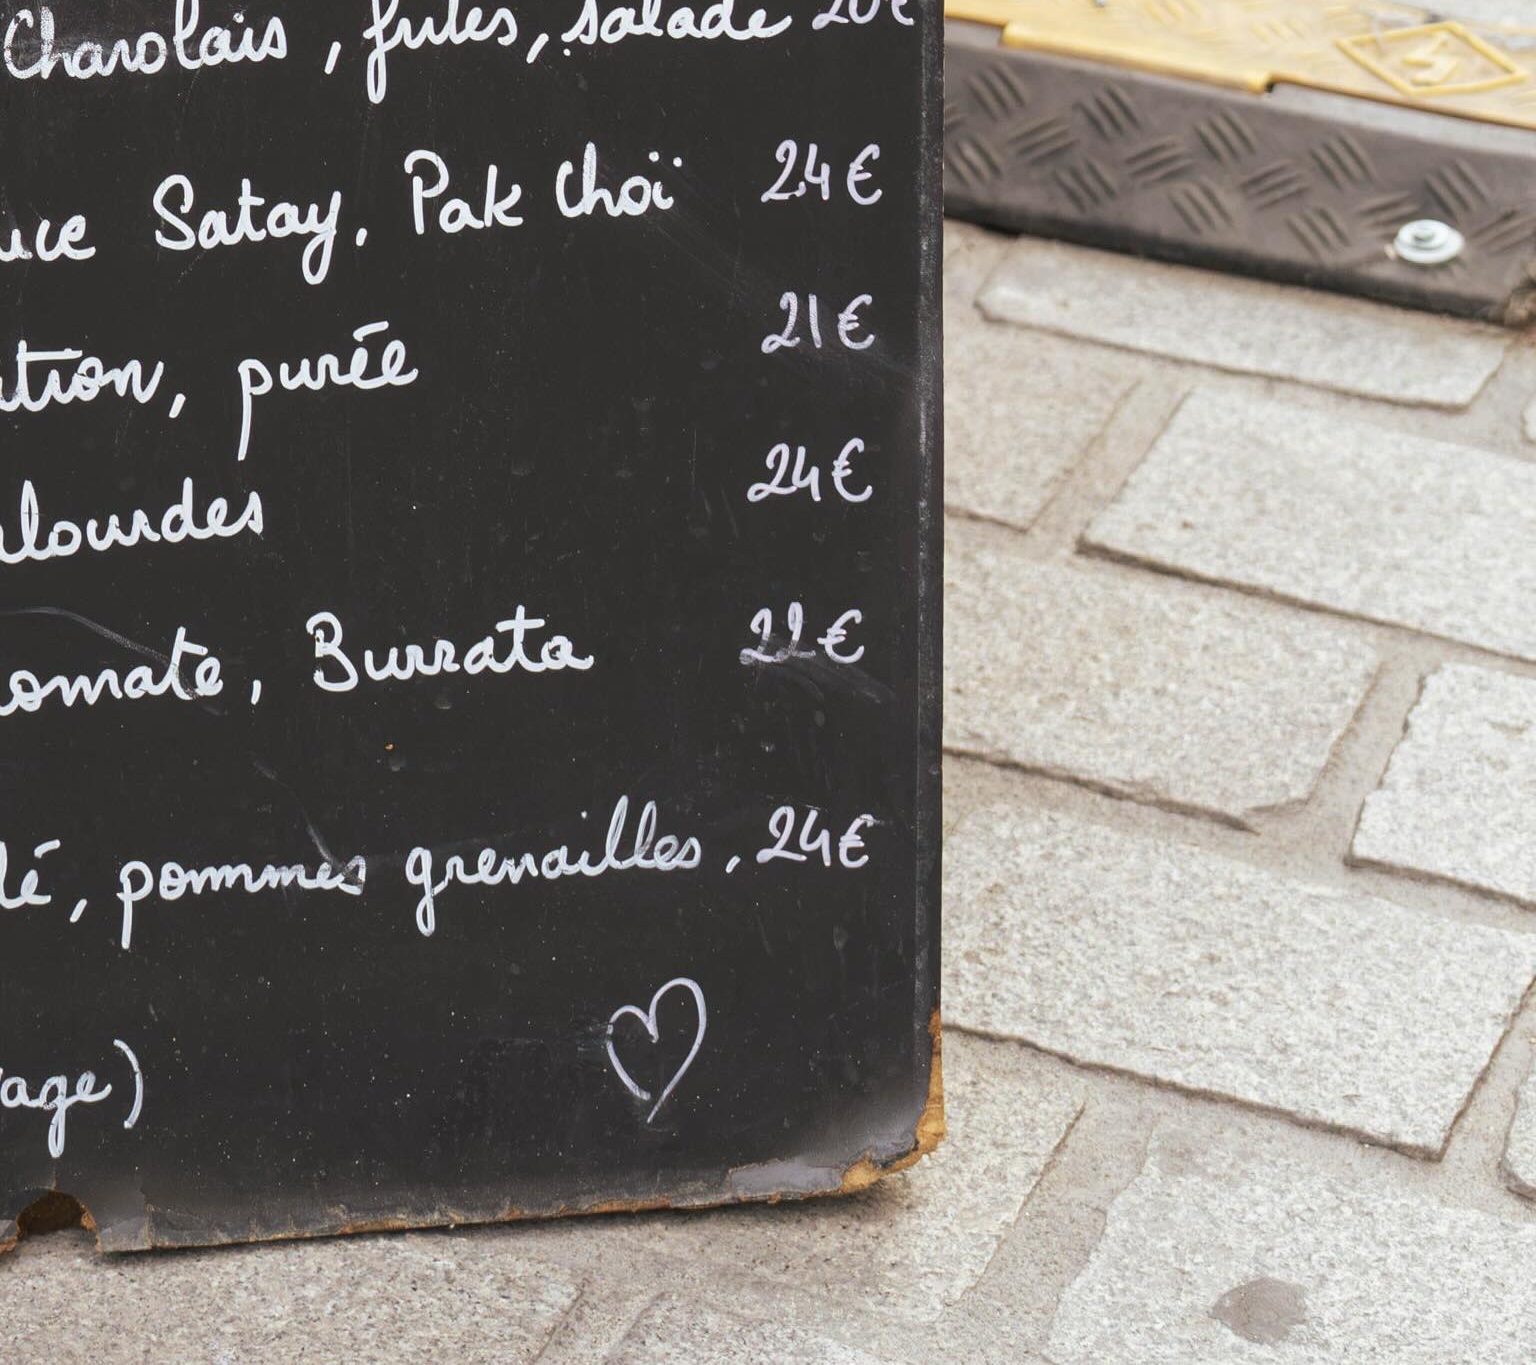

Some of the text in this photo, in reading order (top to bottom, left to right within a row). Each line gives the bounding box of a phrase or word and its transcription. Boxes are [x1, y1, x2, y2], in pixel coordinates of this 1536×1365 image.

[404, 150, 523, 235] Pak
[761, 140, 882, 205] 24€
[761, 292, 875, 353] 21€
[238, 321, 418, 461] purée
[747, 438, 872, 502] 24€
[306, 605, 594, 692] Burrata
[740, 602, 864, 664] 22€
[756, 805, 879, 868] 24€
[116, 840, 366, 949] pommes
